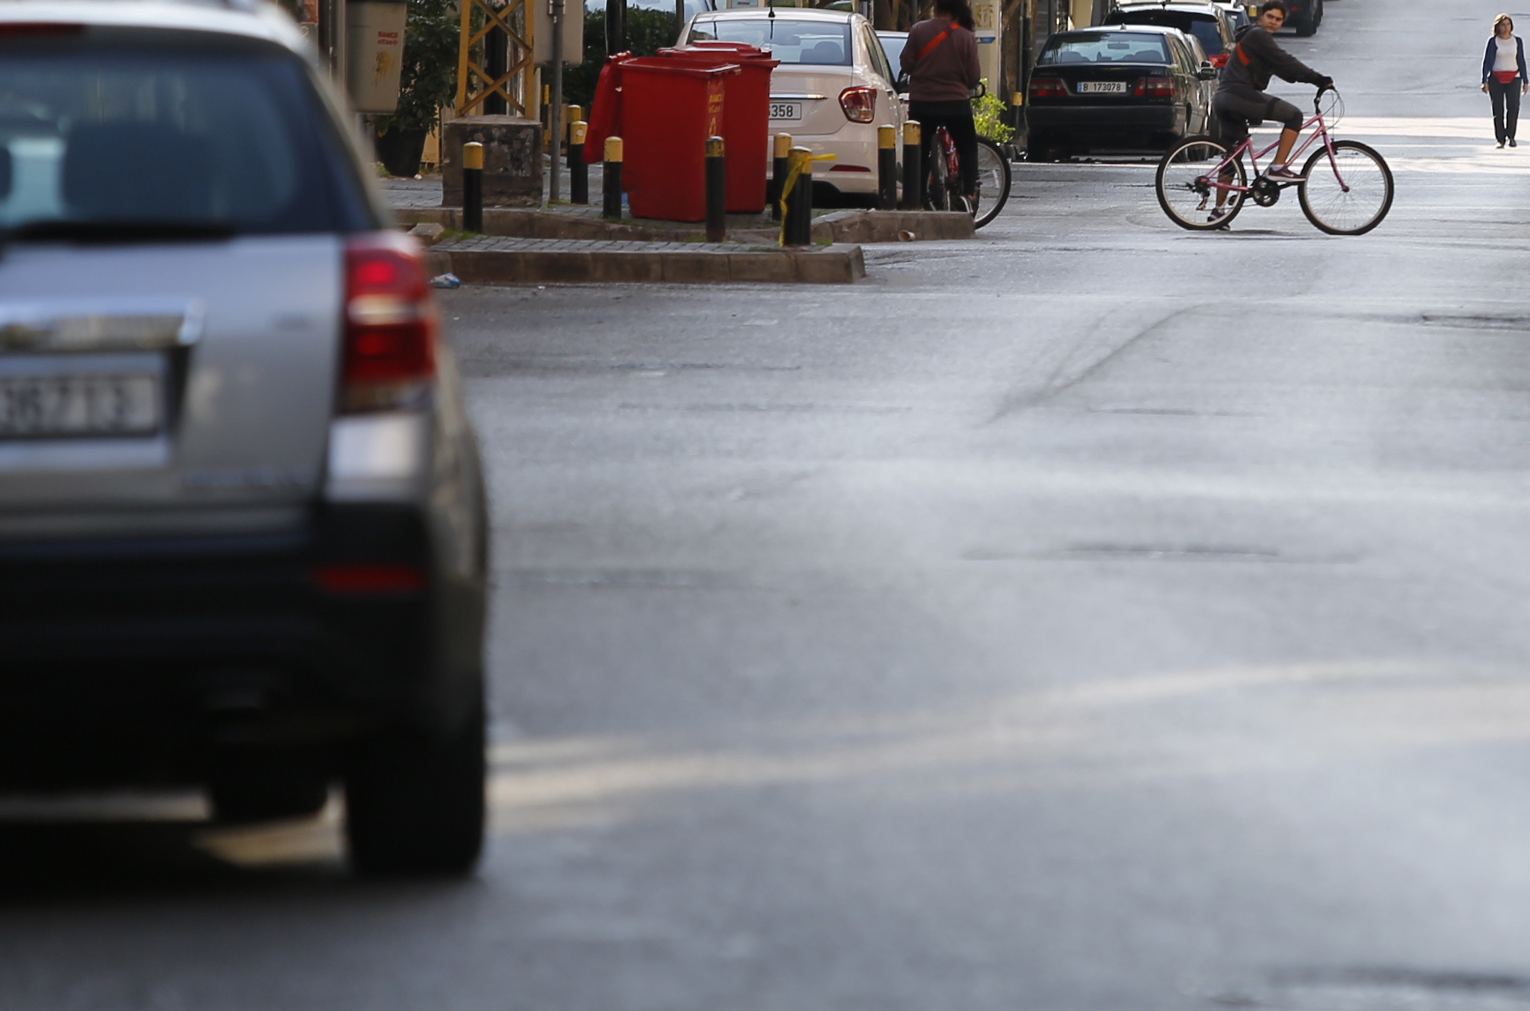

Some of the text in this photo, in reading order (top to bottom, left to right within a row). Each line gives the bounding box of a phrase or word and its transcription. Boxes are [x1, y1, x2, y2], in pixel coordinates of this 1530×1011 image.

[1083, 82, 1121, 91] B 173078
[769, 105, 793, 118] 358
